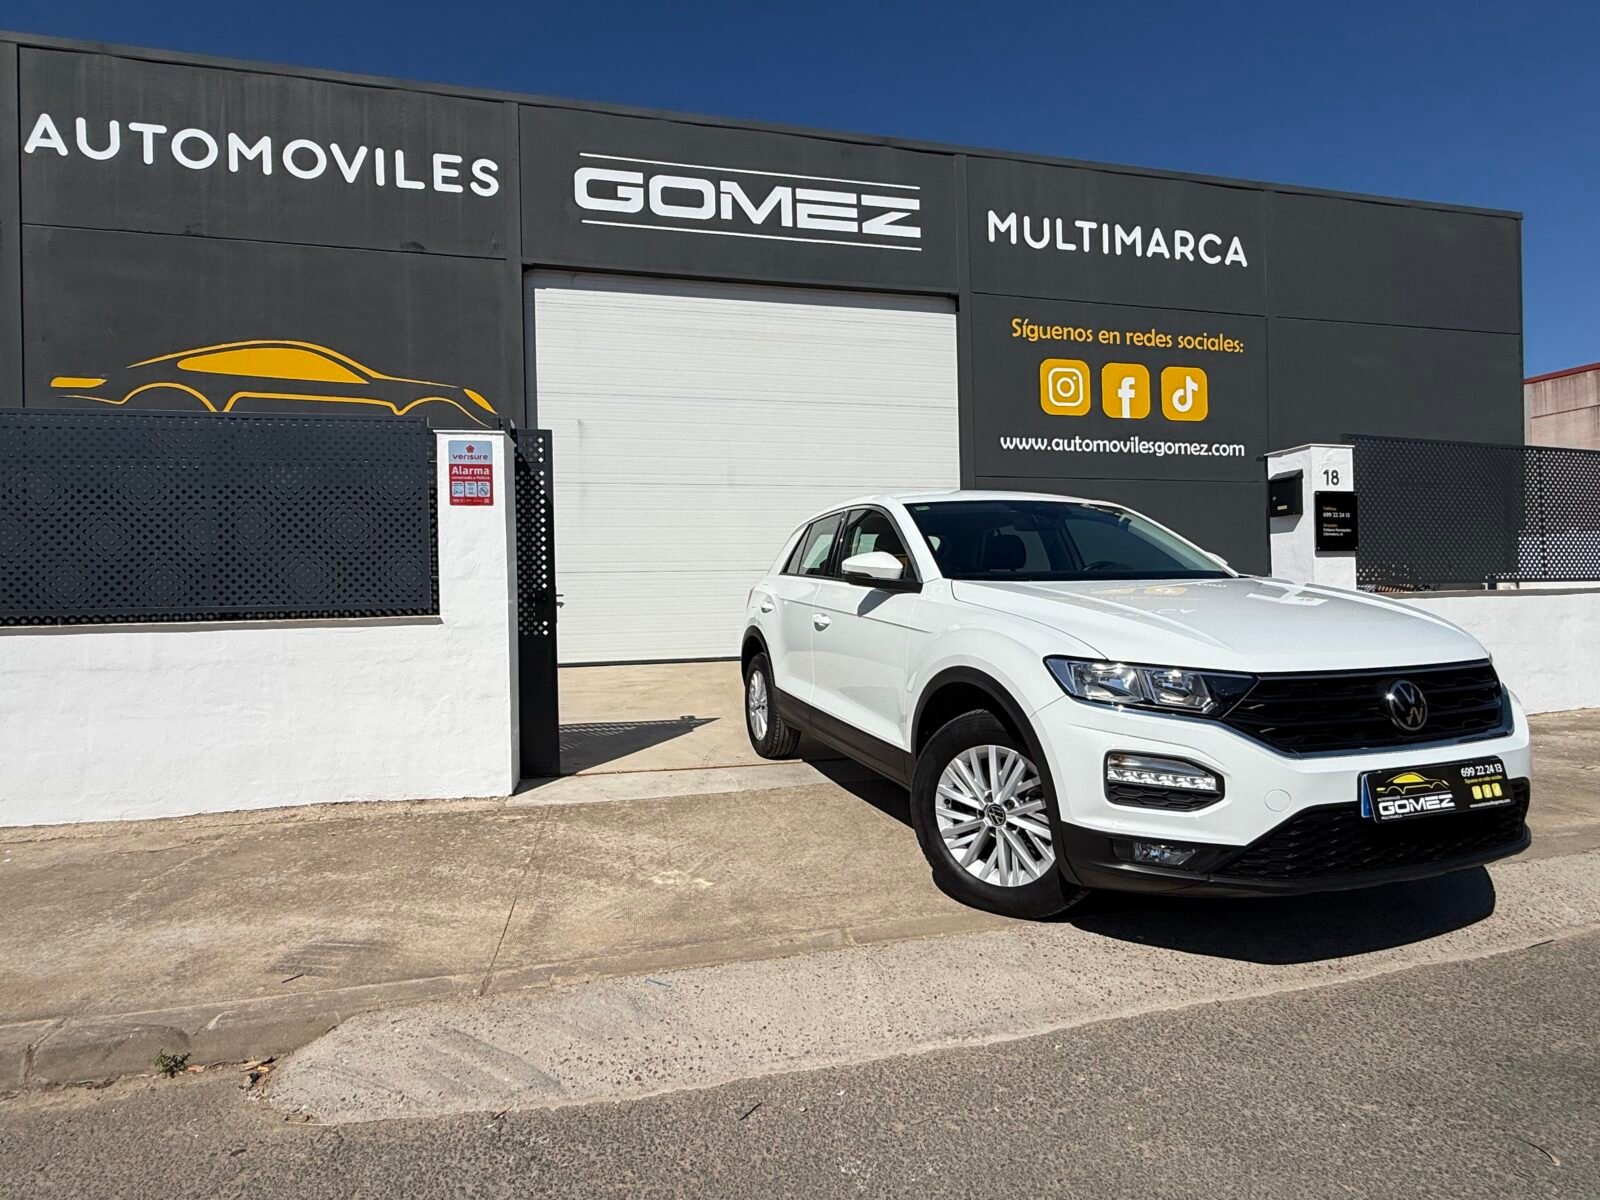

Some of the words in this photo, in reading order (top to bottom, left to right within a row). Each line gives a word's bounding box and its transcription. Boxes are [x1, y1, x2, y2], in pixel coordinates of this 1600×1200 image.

[24, 113, 499, 197] AUTOMOVILES
[574, 167, 921, 238] GOMEZ
[987, 210, 1248, 267] MULTIMARCA
[1011, 318, 1093, 342] Síguenos
[1098, 330, 1121, 345] en
[1126, 329, 1173, 348] redes
[1177, 333, 1244, 353] sociales:
[1000, 436, 1245, 457] www.automovilesgomez.com
[451, 466, 490, 475] Alarma
[1323, 469, 1339, 486] 18
[1461, 767, 1475, 777] 699
[1475, 765, 1486, 775] 22
[1484, 764, 1495, 774] 24
[1379, 794, 1455, 815] GOMEZ
